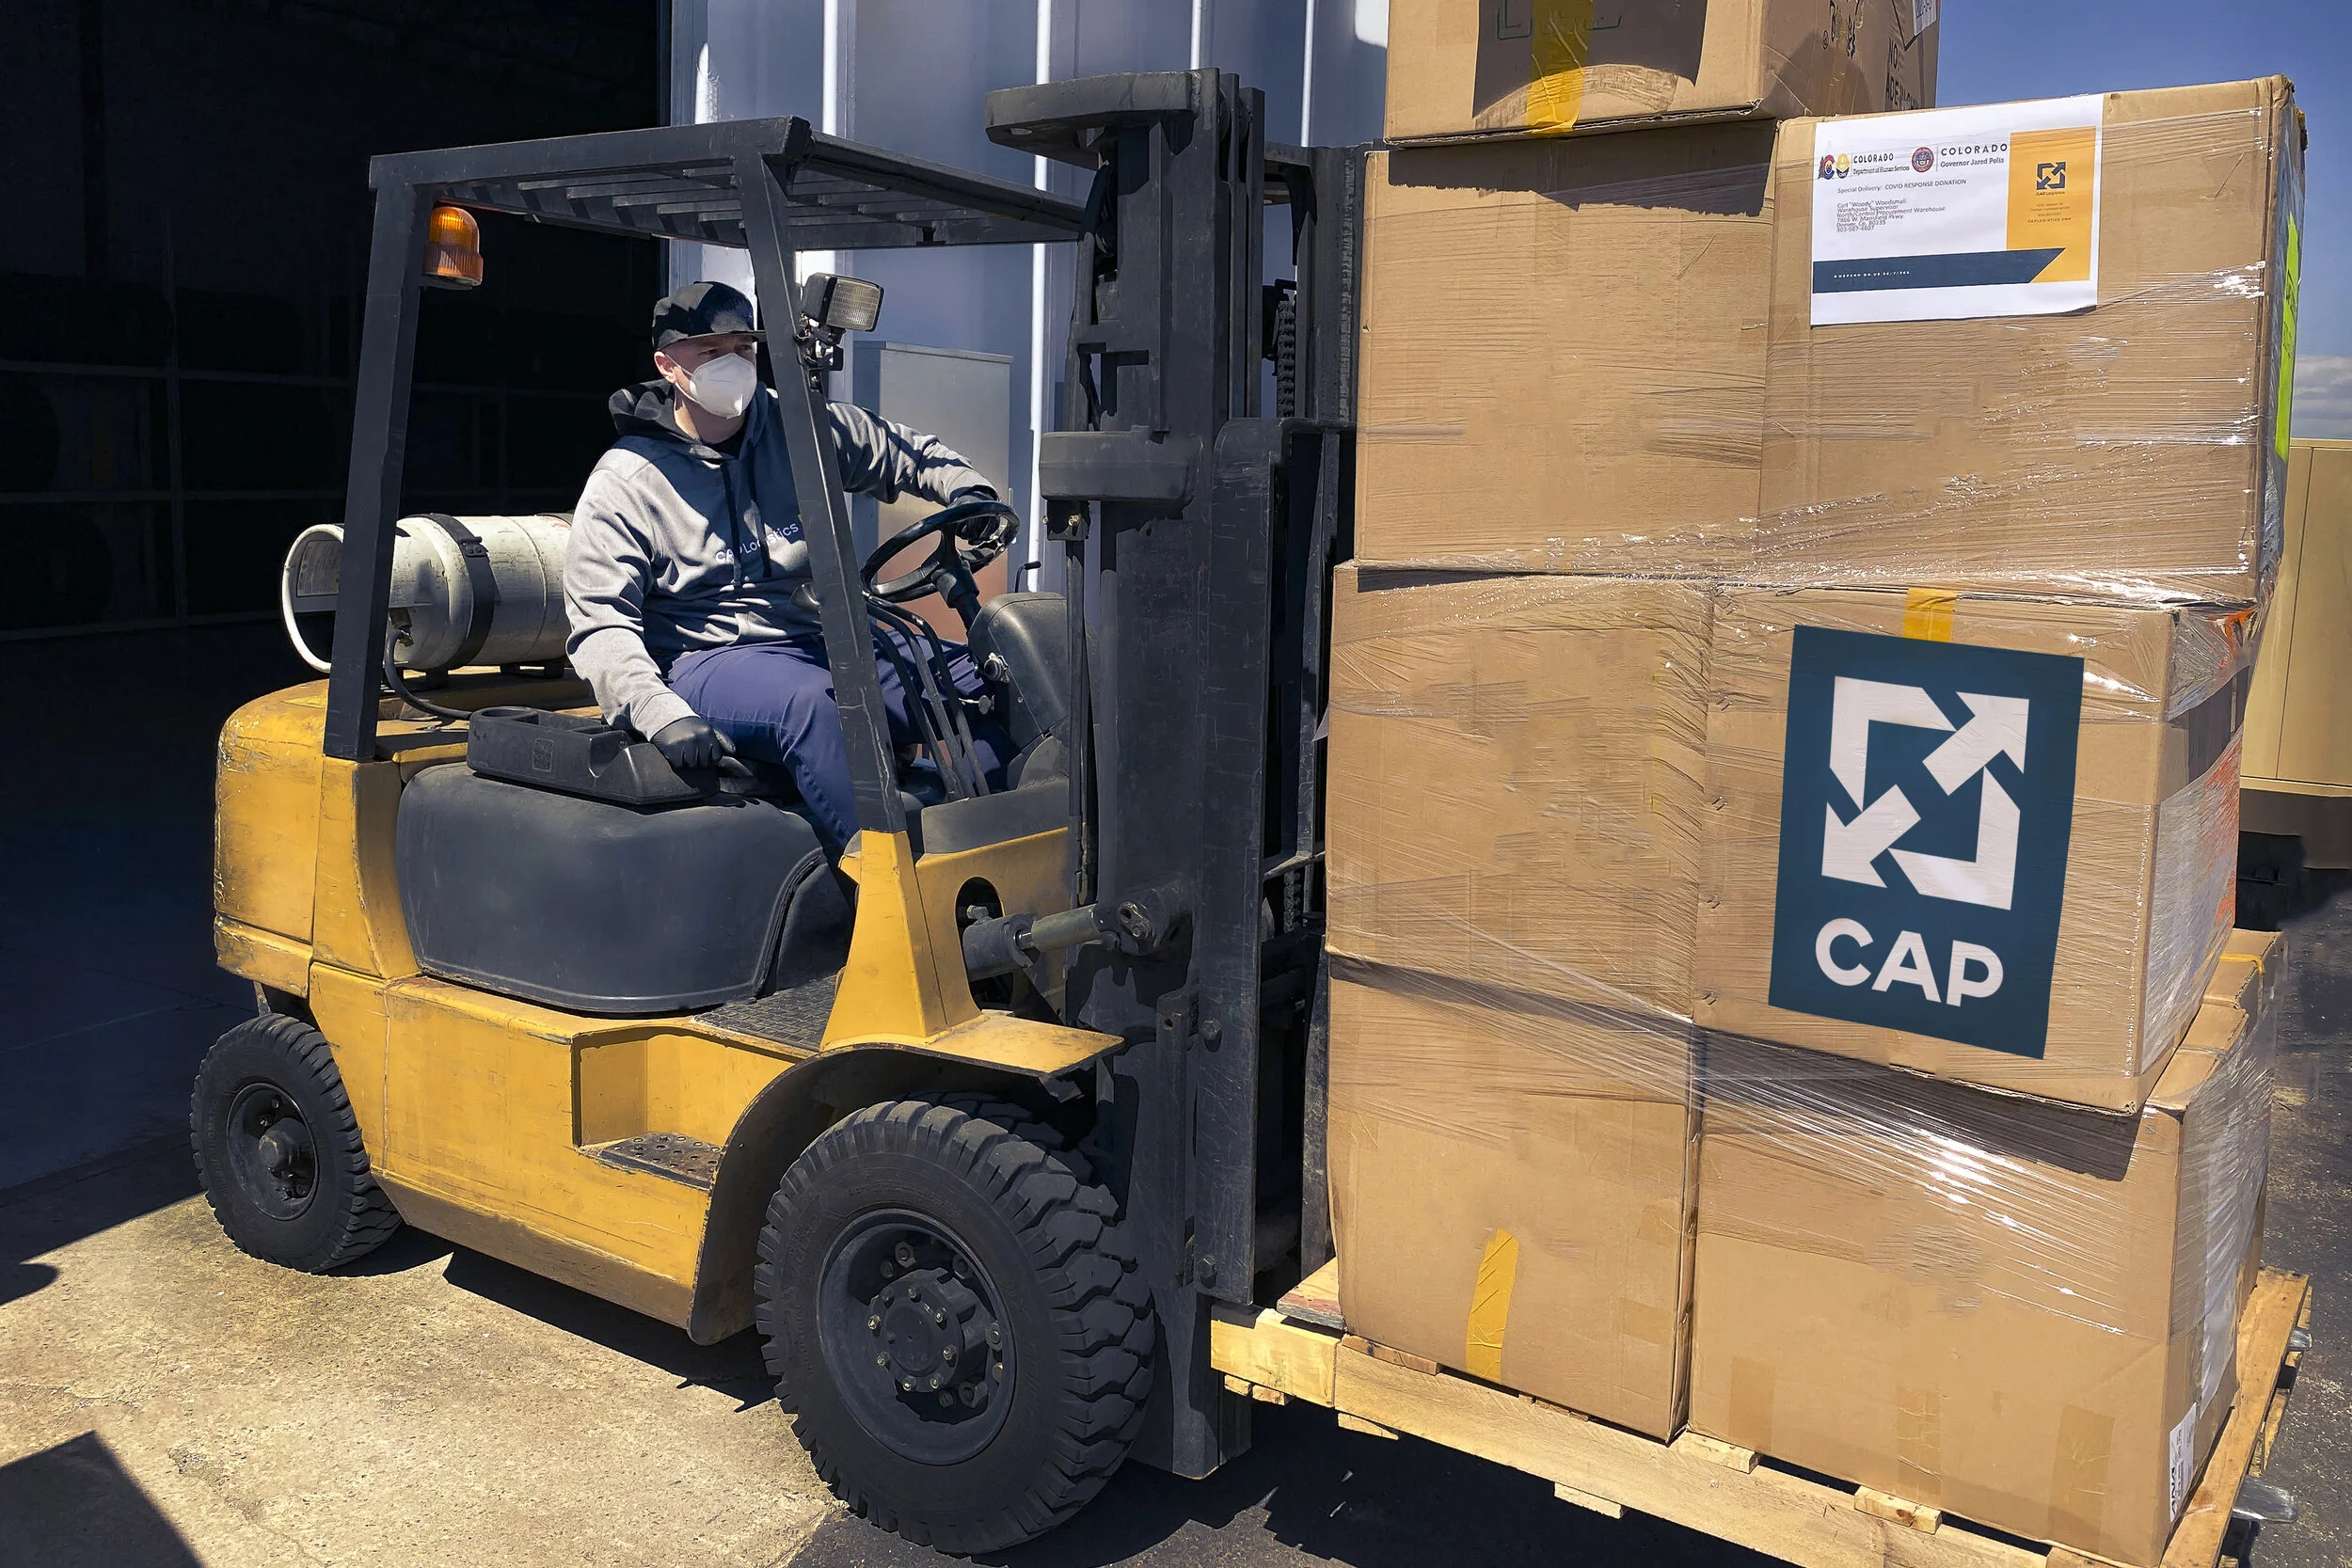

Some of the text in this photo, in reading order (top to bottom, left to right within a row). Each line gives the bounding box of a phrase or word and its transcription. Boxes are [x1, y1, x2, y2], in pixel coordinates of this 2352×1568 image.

[1940, 143, 2008, 156] COLORADO
[1853, 152, 1894, 164] COLORADO
[1940, 160, 1969, 168] Governor
[1852, 167, 1875, 176] Department
[1934, 179, 1966, 187] DONATION
[1876, 208, 1913, 216] Procurement
[1815, 917, 2004, 1007] CAP
